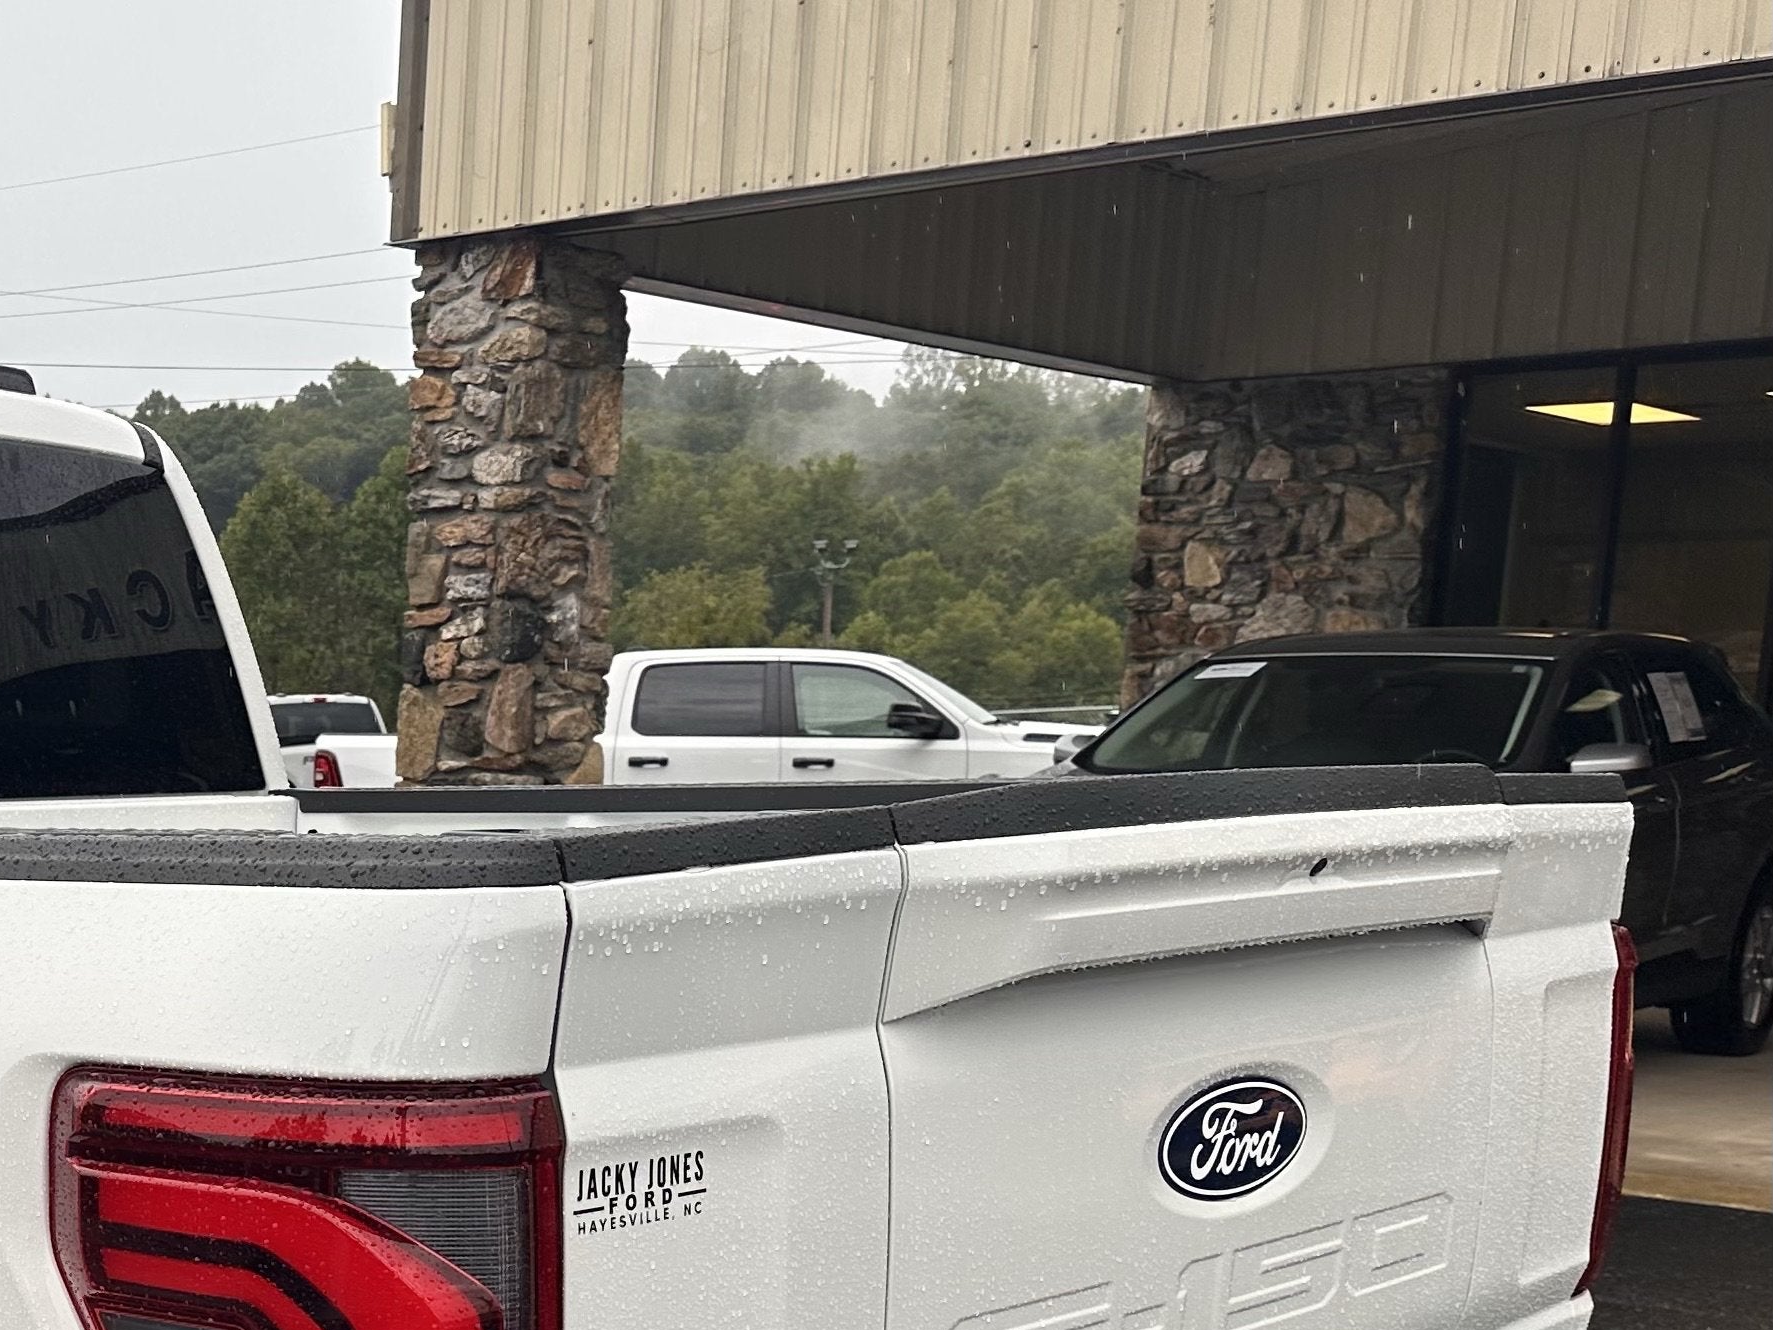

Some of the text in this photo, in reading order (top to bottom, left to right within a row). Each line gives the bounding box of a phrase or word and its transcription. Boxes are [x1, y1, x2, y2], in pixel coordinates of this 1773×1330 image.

[1190, 1098, 1285, 1181] Ford
[576, 1150, 704, 1202] JACKY JONES
[578, 1201, 702, 1235] HAYESVILLE, NC
[609, 1188, 673, 1214] FORD
